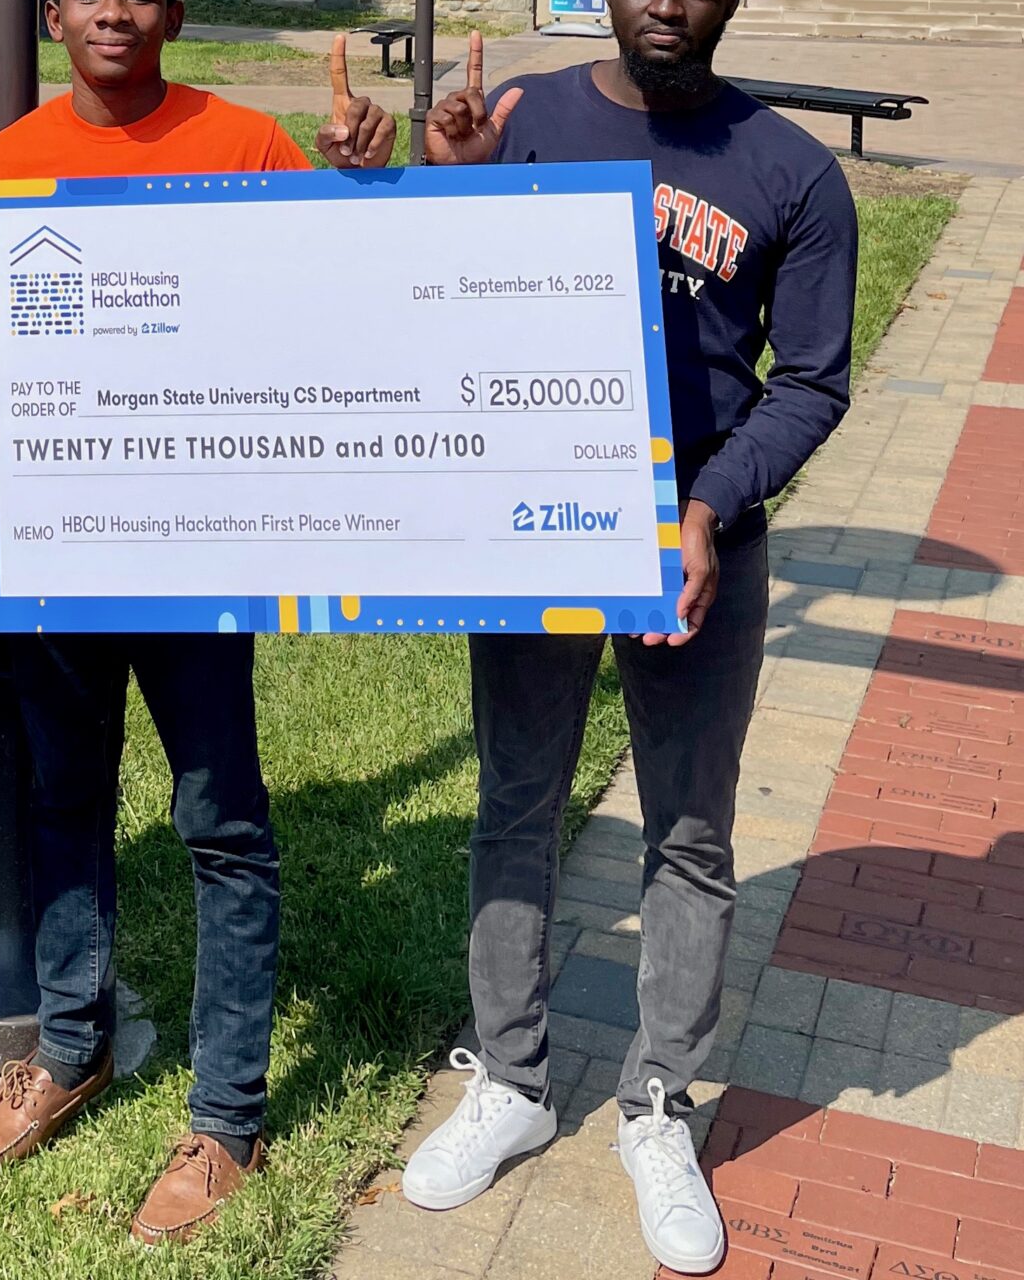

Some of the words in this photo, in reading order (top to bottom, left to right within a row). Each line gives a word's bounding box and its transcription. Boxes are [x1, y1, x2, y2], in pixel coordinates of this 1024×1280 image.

[654, 183, 749, 283] STATE
[91, 272, 127, 287] HBCU
[130, 271, 180, 288] Housing
[413, 286, 444, 300] DATE
[459, 276, 542, 297] September
[548, 275, 569, 294] 16,
[574, 274, 614, 291] 2022
[659, 269, 705, 300] TY
[92, 290, 180, 308] Hackathon
[93, 325, 126, 336] powered
[127, 324, 138, 336] by
[151, 323, 179, 334] Zillow
[11, 382, 33, 397] PAY
[36, 382, 54, 396] TO
[58, 381, 81, 394] THE
[97, 389, 158, 410] Morgan
[163, 388, 204, 406] State
[209, 387, 289, 408] University
[294, 386, 317, 404] CS
[322, 386, 420, 407] Department
[461, 373, 475, 406] $
[489, 377, 624, 410] 25,000.00
[11, 402, 55, 417] ORDER
[58, 402, 76, 416] OF
[13, 438, 113, 462] TWENTY
[124, 437, 176, 460] FIVE
[186, 436, 324, 459] THOUSAND
[336, 435, 382, 458] and
[394, 432, 485, 459] 00/100
[574, 444, 637, 460] DOLLARS
[13, 525, 54, 541] MEMO
[62, 516, 106, 533] HBCU
[110, 516, 170, 536] Housing
[175, 515, 256, 532] Hackathon
[262, 514, 294, 532] First
[299, 514, 341, 532] Place
[345, 514, 400, 531] Winner
[540, 502, 618, 531] Zillow
